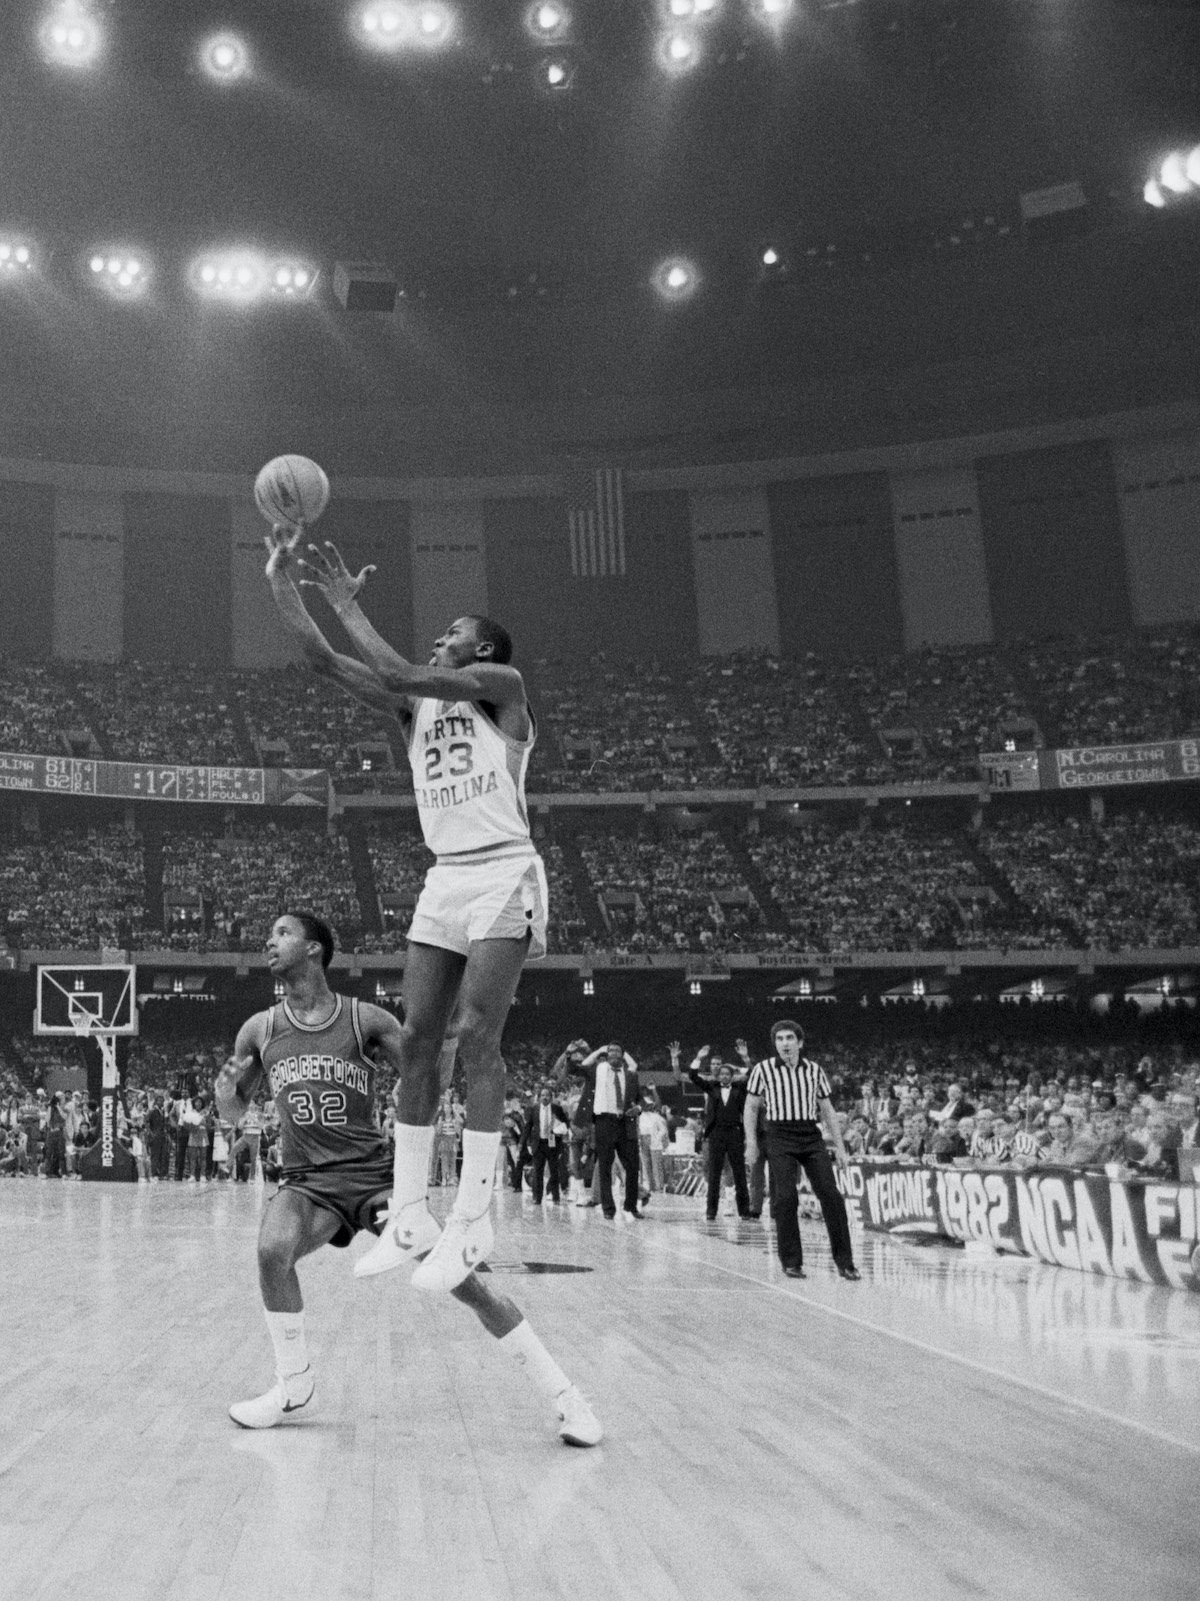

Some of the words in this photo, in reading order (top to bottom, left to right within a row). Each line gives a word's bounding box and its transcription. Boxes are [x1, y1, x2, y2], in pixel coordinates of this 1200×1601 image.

[424, 716, 477, 745] RTH
[45, 773, 70, 789] 62
[46, 759, 67, 774] 61
[425, 742, 474, 782] 23
[288, 1090, 348, 1126] 32
[102, 1095, 115, 1168] SUPERDOME
[866, 1170, 934, 1225] WELCOME
[936, 1171, 1021, 1253] 1982
[1015, 1175, 1154, 1284] NCAA
[1144, 1185, 1200, 1242] FI
